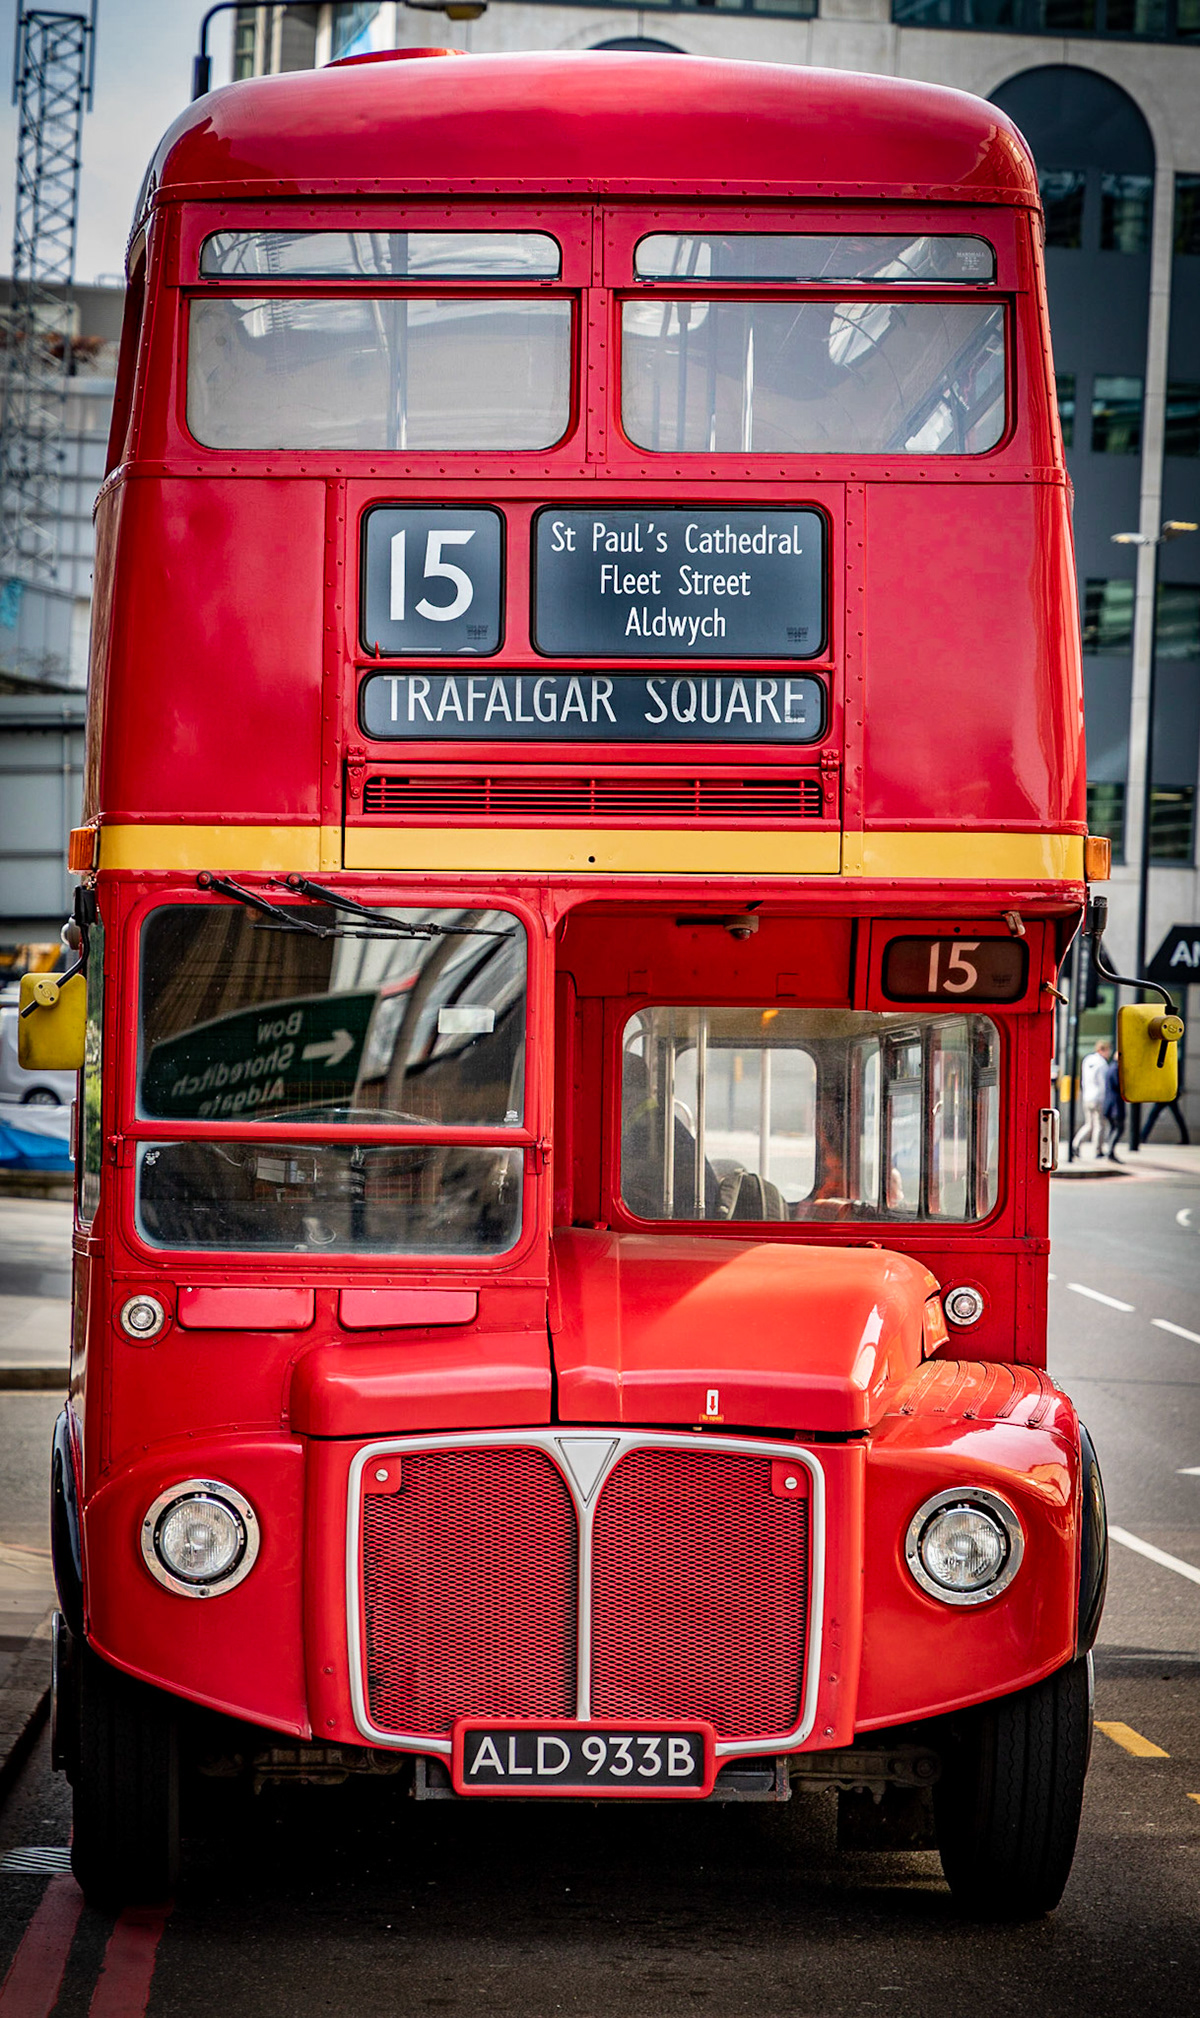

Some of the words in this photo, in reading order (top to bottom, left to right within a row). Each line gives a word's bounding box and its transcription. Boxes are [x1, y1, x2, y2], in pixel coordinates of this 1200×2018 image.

[550, 521, 577, 552] St
[592, 522, 668, 553] Paul's
[685, 523, 803, 555] Cathedral
[390, 529, 477, 622] 15
[600, 564, 662, 595] Fleet
[678, 564, 752, 596] Street
[625, 606, 726, 647] Aldwych
[383, 675, 617, 723] TRAFALGAR
[644, 676, 806, 724] SQUARE
[928, 942, 981, 993] 15
[469, 1736, 571, 1775] ALD
[581, 1736, 696, 1778] 933B
